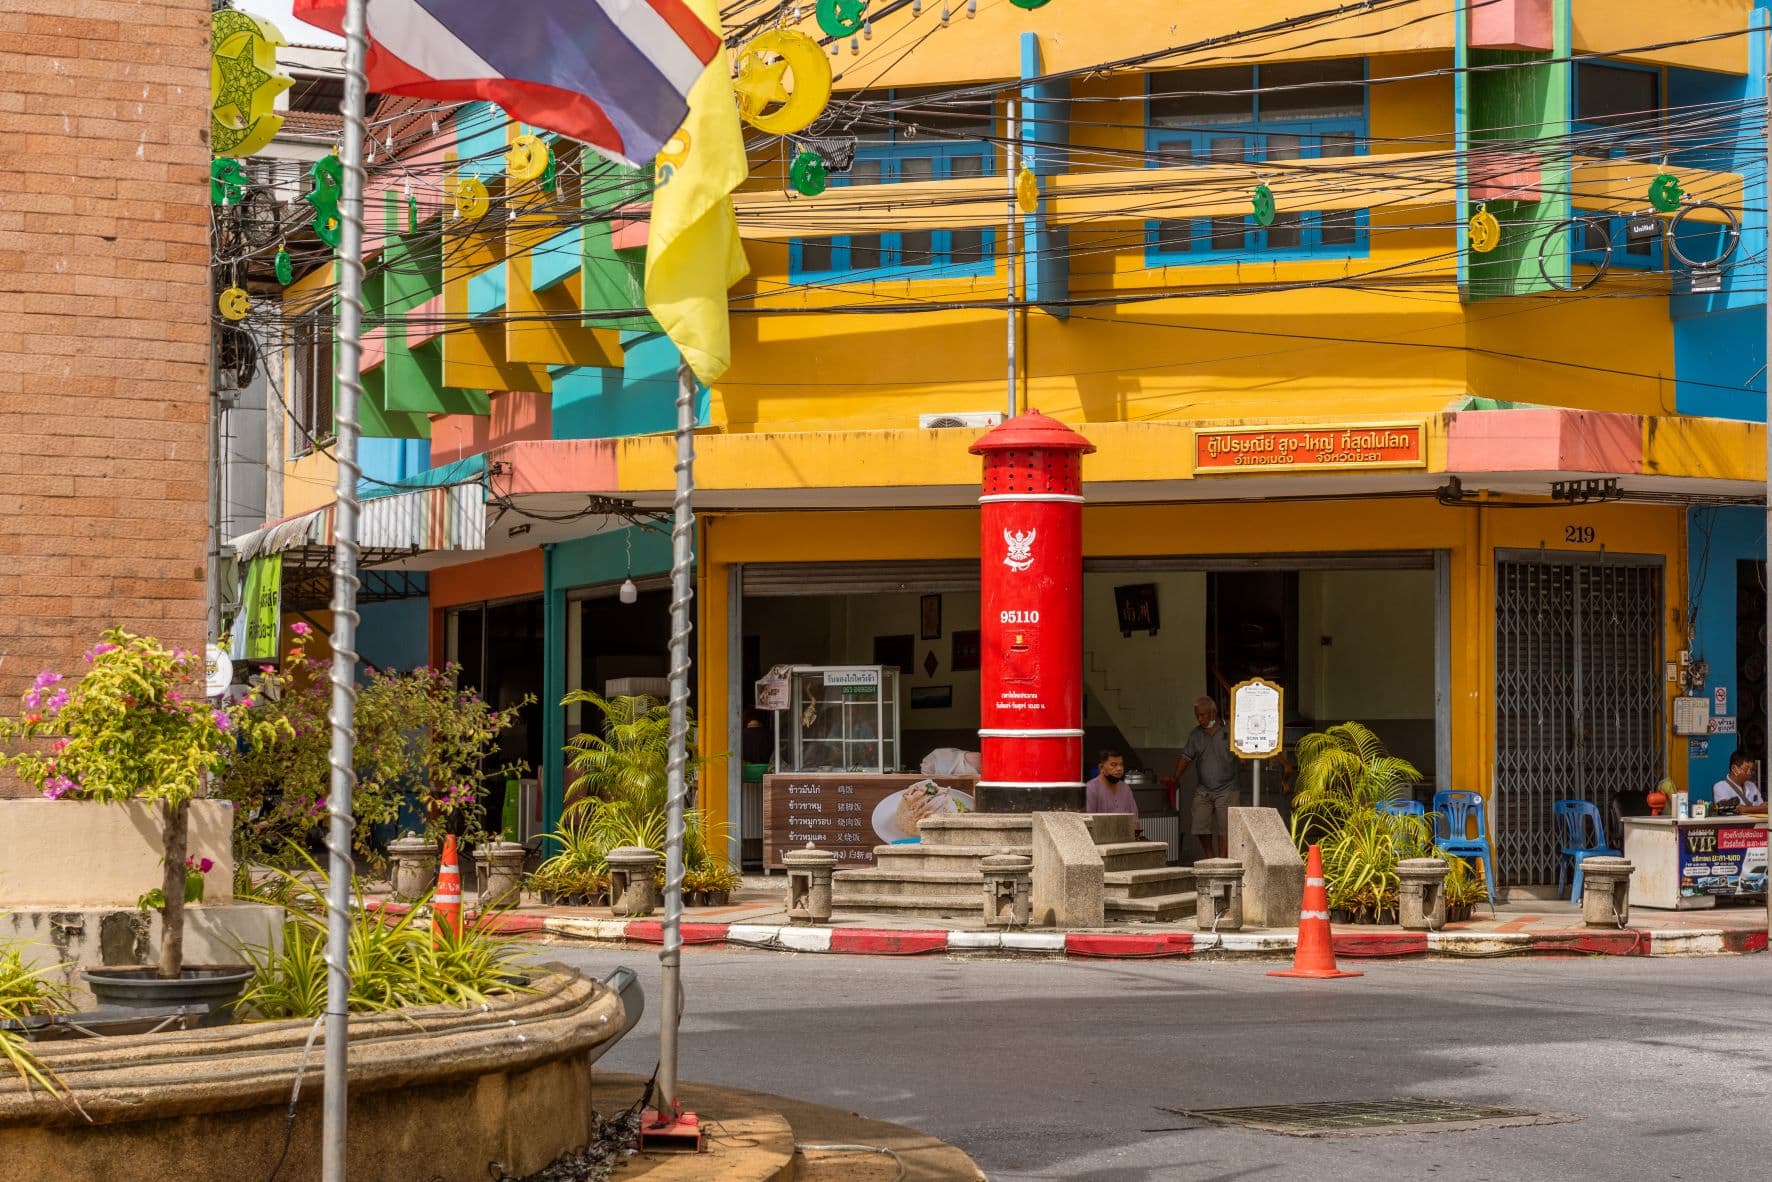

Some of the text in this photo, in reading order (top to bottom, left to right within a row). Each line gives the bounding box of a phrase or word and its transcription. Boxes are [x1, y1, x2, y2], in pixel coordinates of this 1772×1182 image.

[1207, 429, 1410, 459] ตู้ไปรษณีย์ สูง-ใหญ่ ที่สุดในโลก
[1234, 450, 1382, 465] อำเภอเบตง จังหวัดยะลา
[1565, 525, 1595, 544] 219
[1000, 610, 1040, 624] 95110
[788, 784, 821, 794] ข้าวมันไก่
[788, 800, 822, 812] ข้าวขาหมู
[788, 815, 832, 828] ข้าวหมูกรอบ
[788, 831, 827, 841] ข้าวหมแดง
[1687, 836, 1717, 853] VIP
